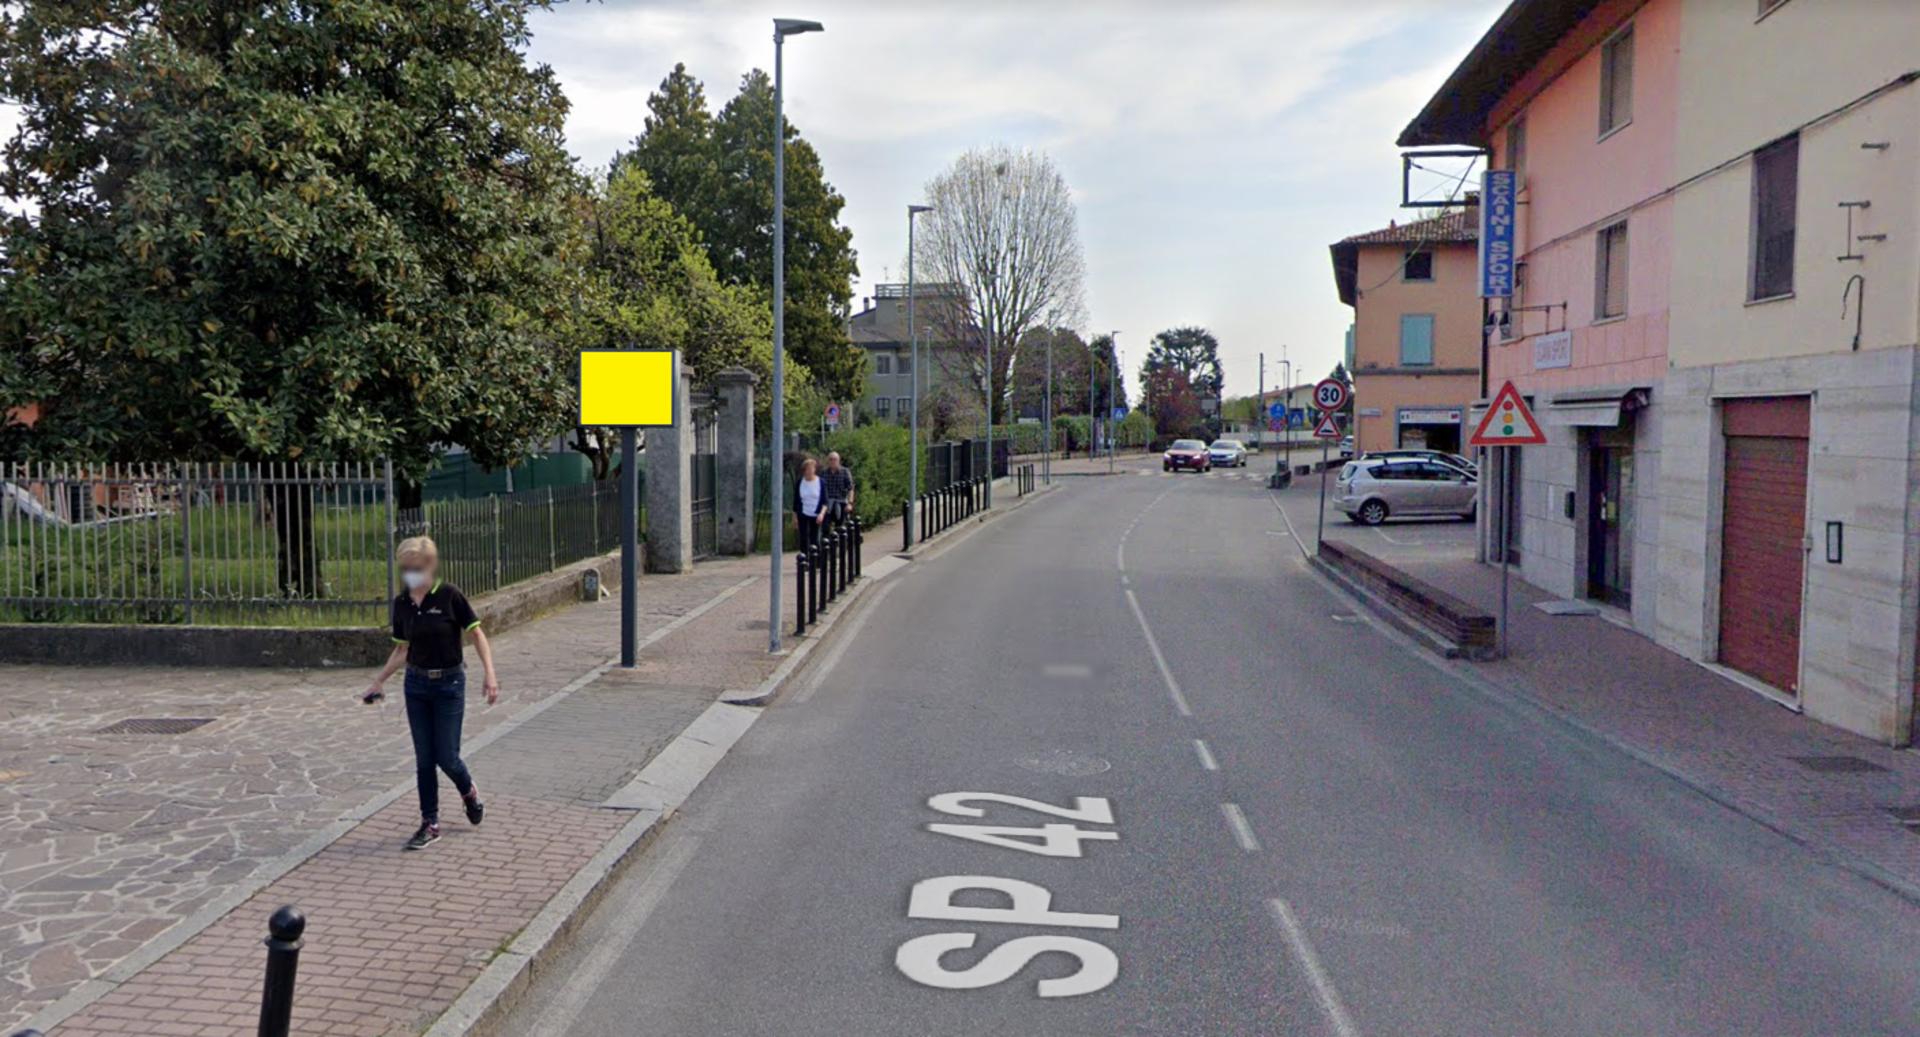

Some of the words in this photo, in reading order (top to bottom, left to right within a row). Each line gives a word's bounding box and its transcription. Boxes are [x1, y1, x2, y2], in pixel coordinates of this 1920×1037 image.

[1490, 172, 1511, 236] SCAINI
[1488, 240, 1510, 296] SPORT
[1320, 387, 1340, 403] 30
